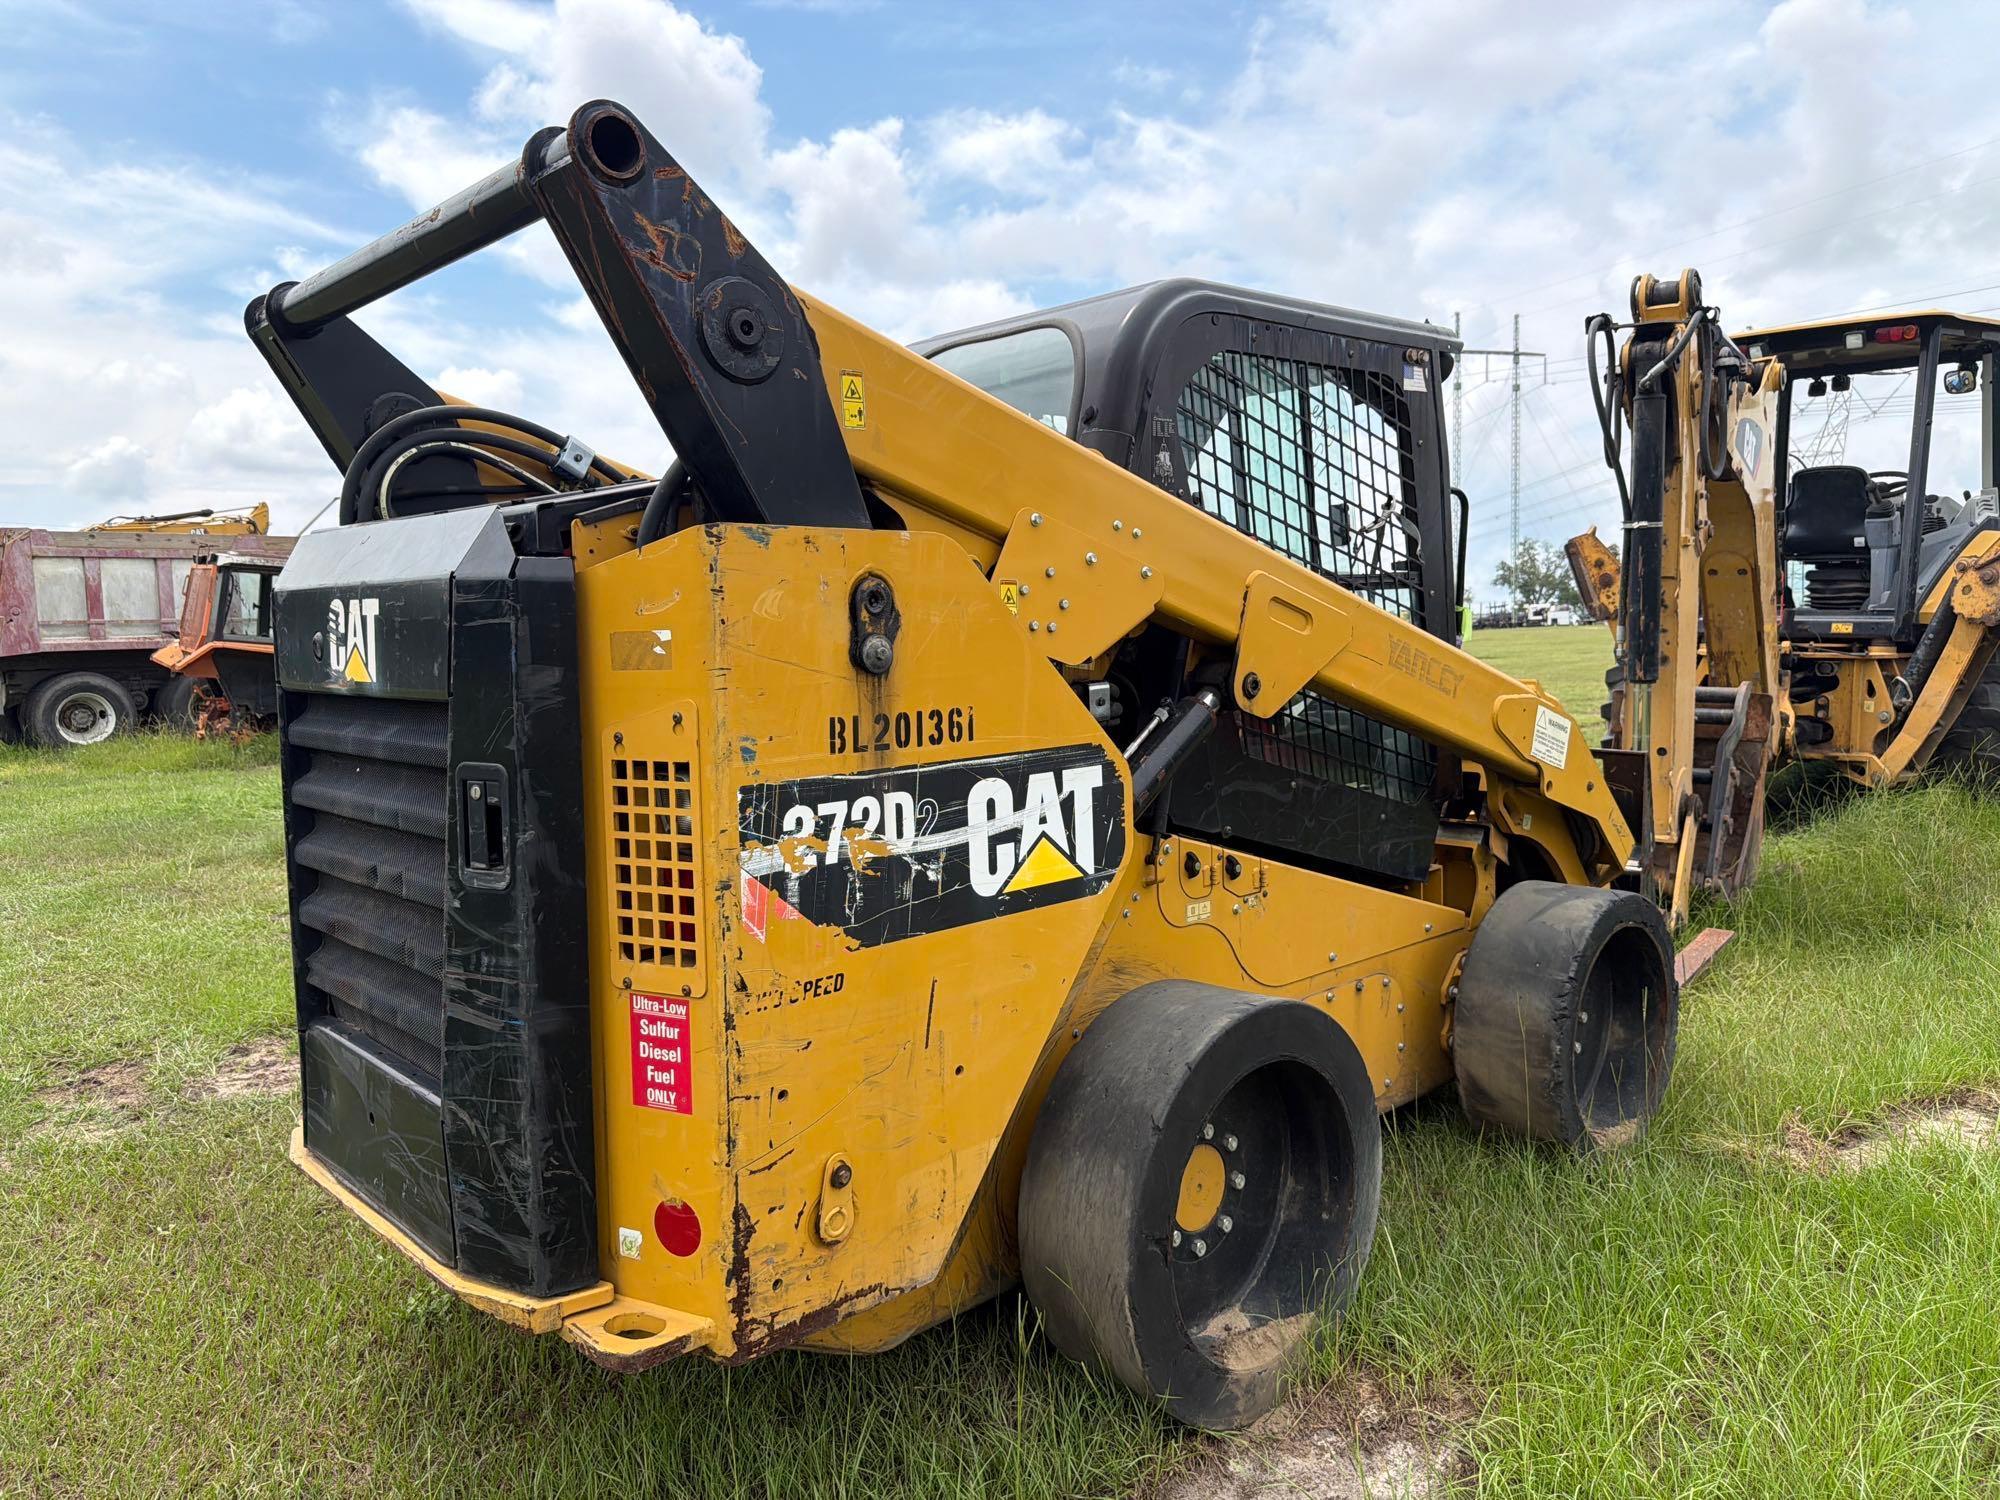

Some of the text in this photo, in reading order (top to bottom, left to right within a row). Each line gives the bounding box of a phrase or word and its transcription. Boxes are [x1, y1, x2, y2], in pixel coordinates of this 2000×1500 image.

[328, 598, 380, 683] CAT
[829, 706, 974, 756] BL201361
[1548, 718, 1569, 734] WARNING
[967, 764, 1103, 897] CAT
[633, 994, 687, 1016] Ultra-Low
[639, 1018, 680, 1040] Sulfur
[639, 1041, 682, 1063] Diesel
[647, 1064, 675, 1086] Fuel
[646, 1087, 677, 1105] ONLY
